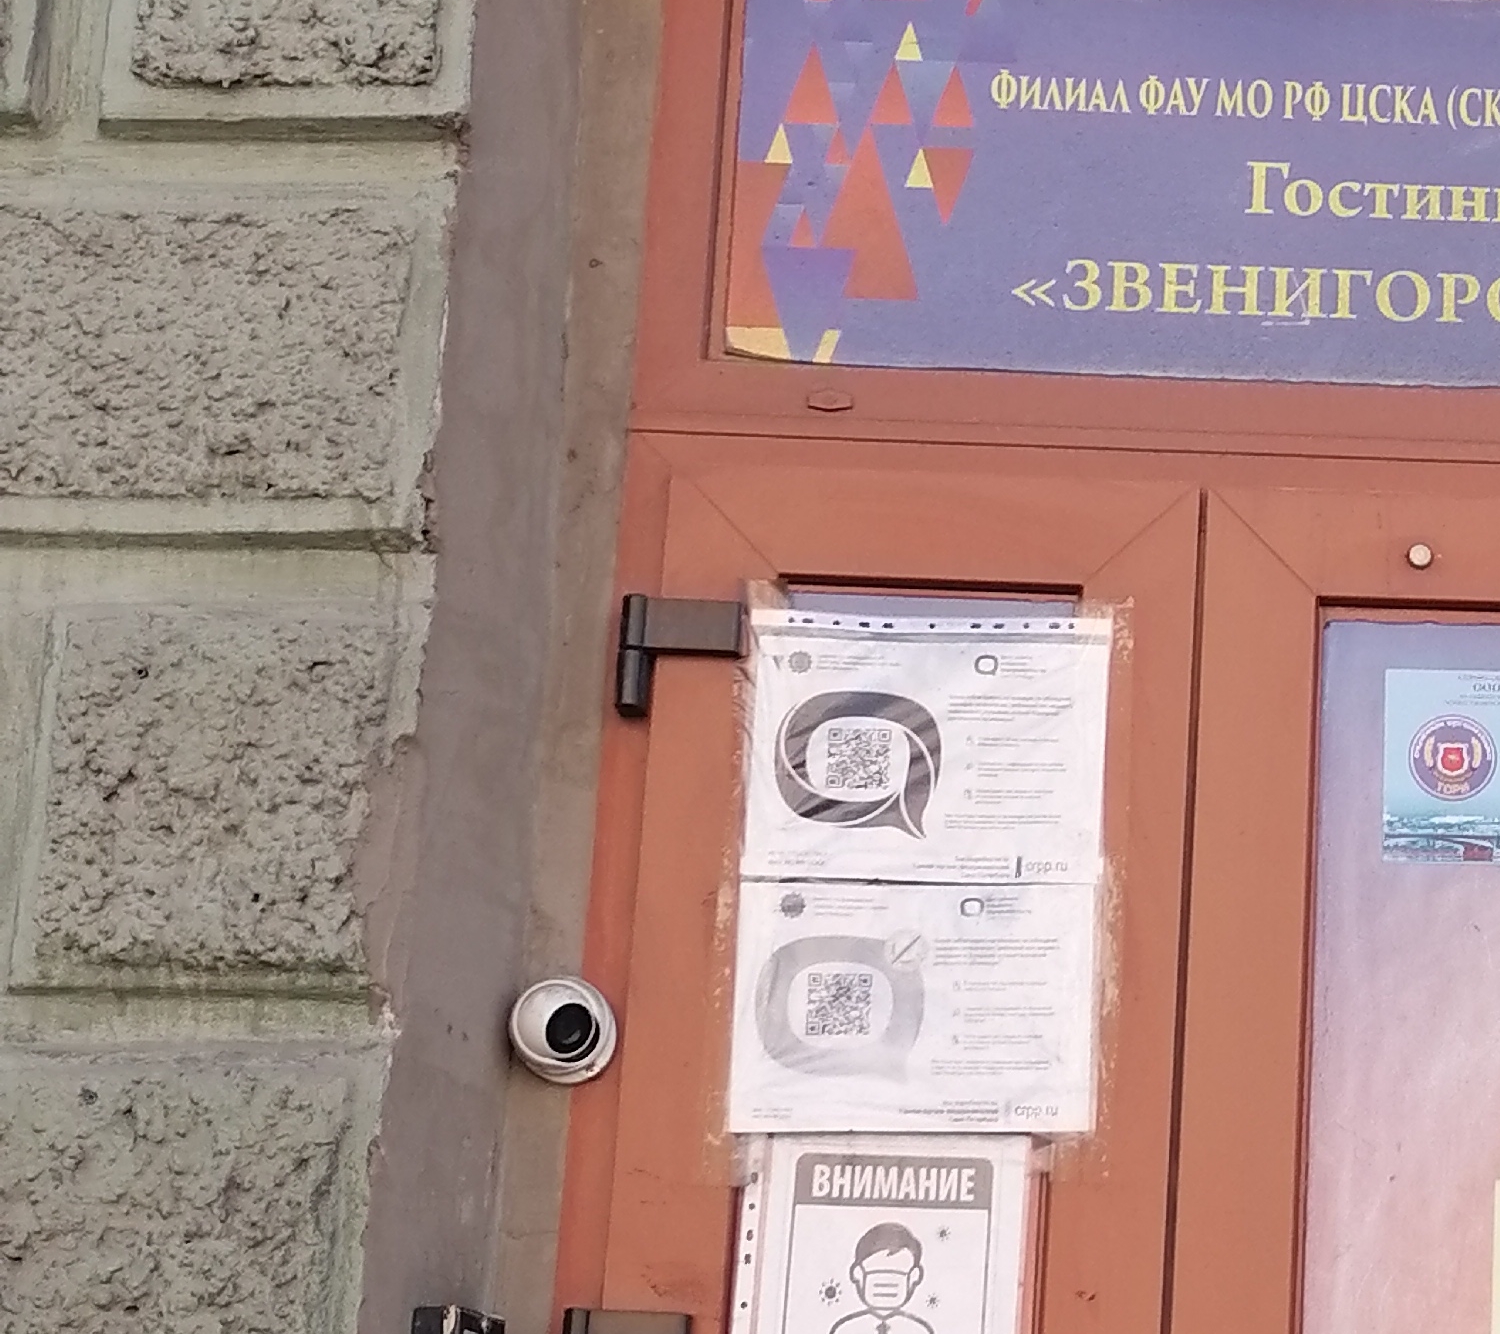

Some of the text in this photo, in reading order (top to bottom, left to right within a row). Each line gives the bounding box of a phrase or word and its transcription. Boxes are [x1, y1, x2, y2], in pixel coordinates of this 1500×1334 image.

[1138, 74, 1211, 116] ФАУ
[1214, 78, 1274, 119] МО
[1282, 80, 1331, 122] РФ
[1338, 83, 1441, 126] ЦСКА
[811, 1163, 976, 1203] ВНИМАНИЕ
